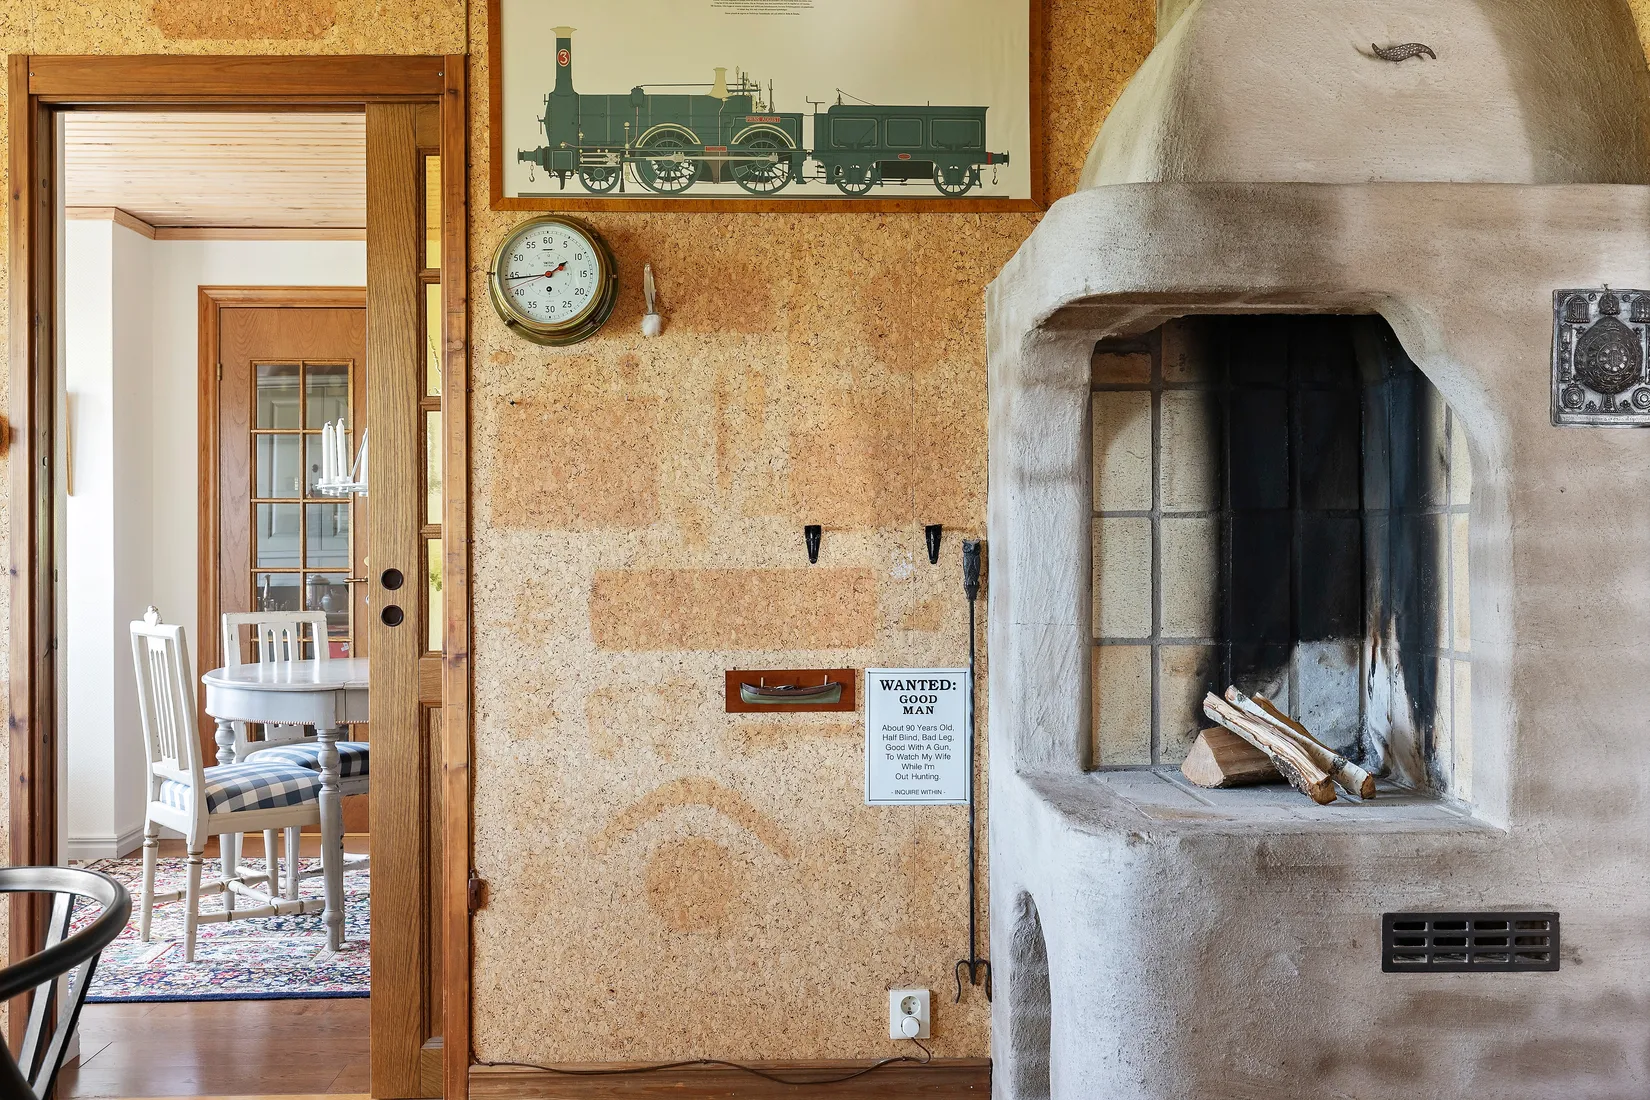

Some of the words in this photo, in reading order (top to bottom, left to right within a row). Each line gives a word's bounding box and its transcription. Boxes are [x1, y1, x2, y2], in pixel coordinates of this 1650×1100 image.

[560, 51, 568, 64] 3
[542, 236, 554, 244] 60
[563, 240, 568, 248] 5
[574, 288, 585, 296] 20
[562, 300, 572, 308] 25
[880, 679, 957, 691] WANTED:
[899, 694, 938, 704] GOOD
[902, 706, 935, 714] MAN
[882, 724, 904, 732] About
[916, 724, 938, 732] Years
[882, 734, 897, 742] Half
[899, 734, 920, 742] Blind,
[922, 734, 937, 742] Bad
[908, 743, 925, 751] With
[922, 753, 933, 762] My
[911, 772, 942, 782] Hunting.
